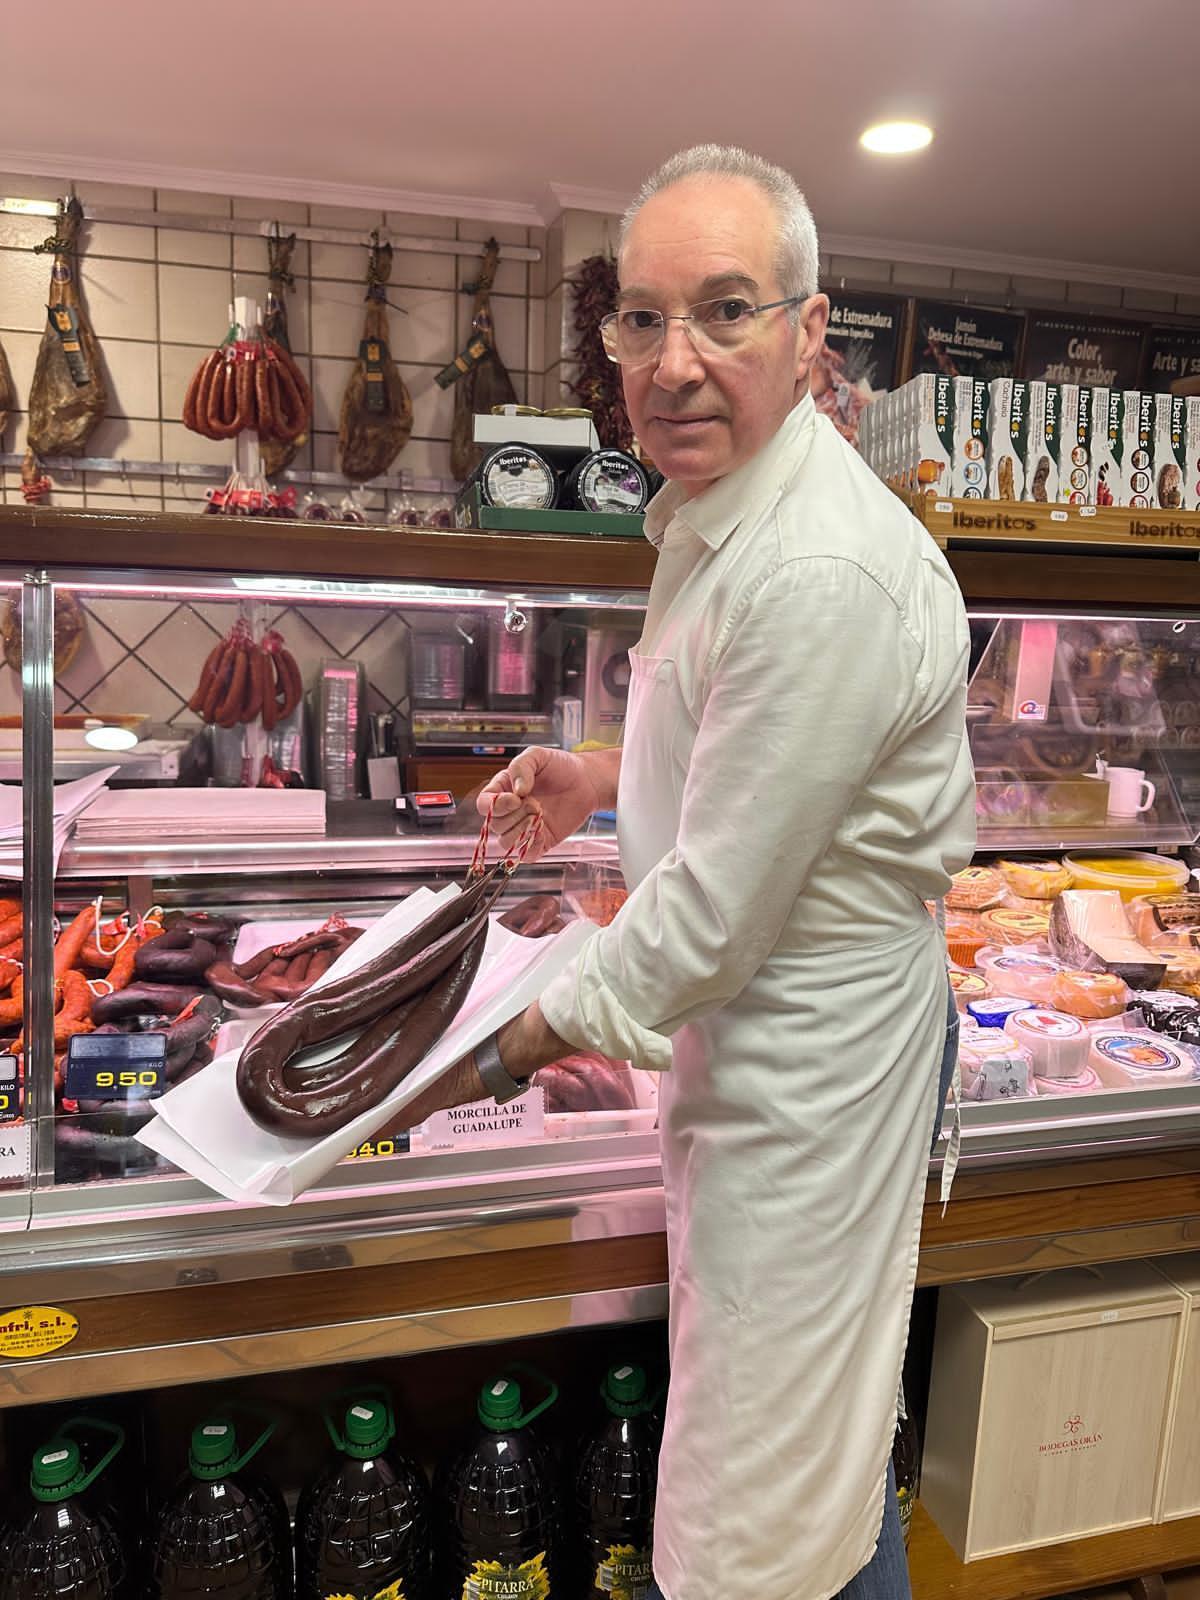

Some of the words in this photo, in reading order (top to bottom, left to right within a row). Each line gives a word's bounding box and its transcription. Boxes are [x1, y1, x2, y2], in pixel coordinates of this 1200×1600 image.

[831, 306, 841, 323] de
[843, 307, 892, 328] Extremadura
[927, 327, 953, 344] Dehesa
[953, 333, 963, 344] de
[963, 333, 1004, 351] Extremadura
[1067, 337, 1102, 363] Color,
[1044, 362, 1071, 381] arte
[1072, 366, 1083, 385] y
[1085, 364, 1118, 385] sabor
[1152, 351, 1178, 371] Arte
[1181, 356, 1189, 376] y
[937, 377, 950, 433] Iberitos
[972, 381, 985, 436] Iberitos
[1011, 383, 1025, 439] Iberitos
[1045, 387, 1057, 440] Iberitos
[1078, 389, 1090, 443] Iberitos
[1140, 394, 1153, 447] Iberitos
[1172, 397, 1184, 449] Iberitos
[499, 455, 527, 466] Iberitos
[602, 459, 629, 471] Iberitos
[952, 511, 1037, 531] Iberitos
[447, 1104, 508, 1121] MORCILLA
[512, 1103, 527, 1115] DE
[452, 1118, 523, 1134] GUADALUPE
[39, 1316, 67, 1328] s.l.
[1039, 1439, 1080, 1453] BODEGAS
[615, 1563, 651, 1576] PITAR
[481, 1578, 534, 1594] PITARRA
